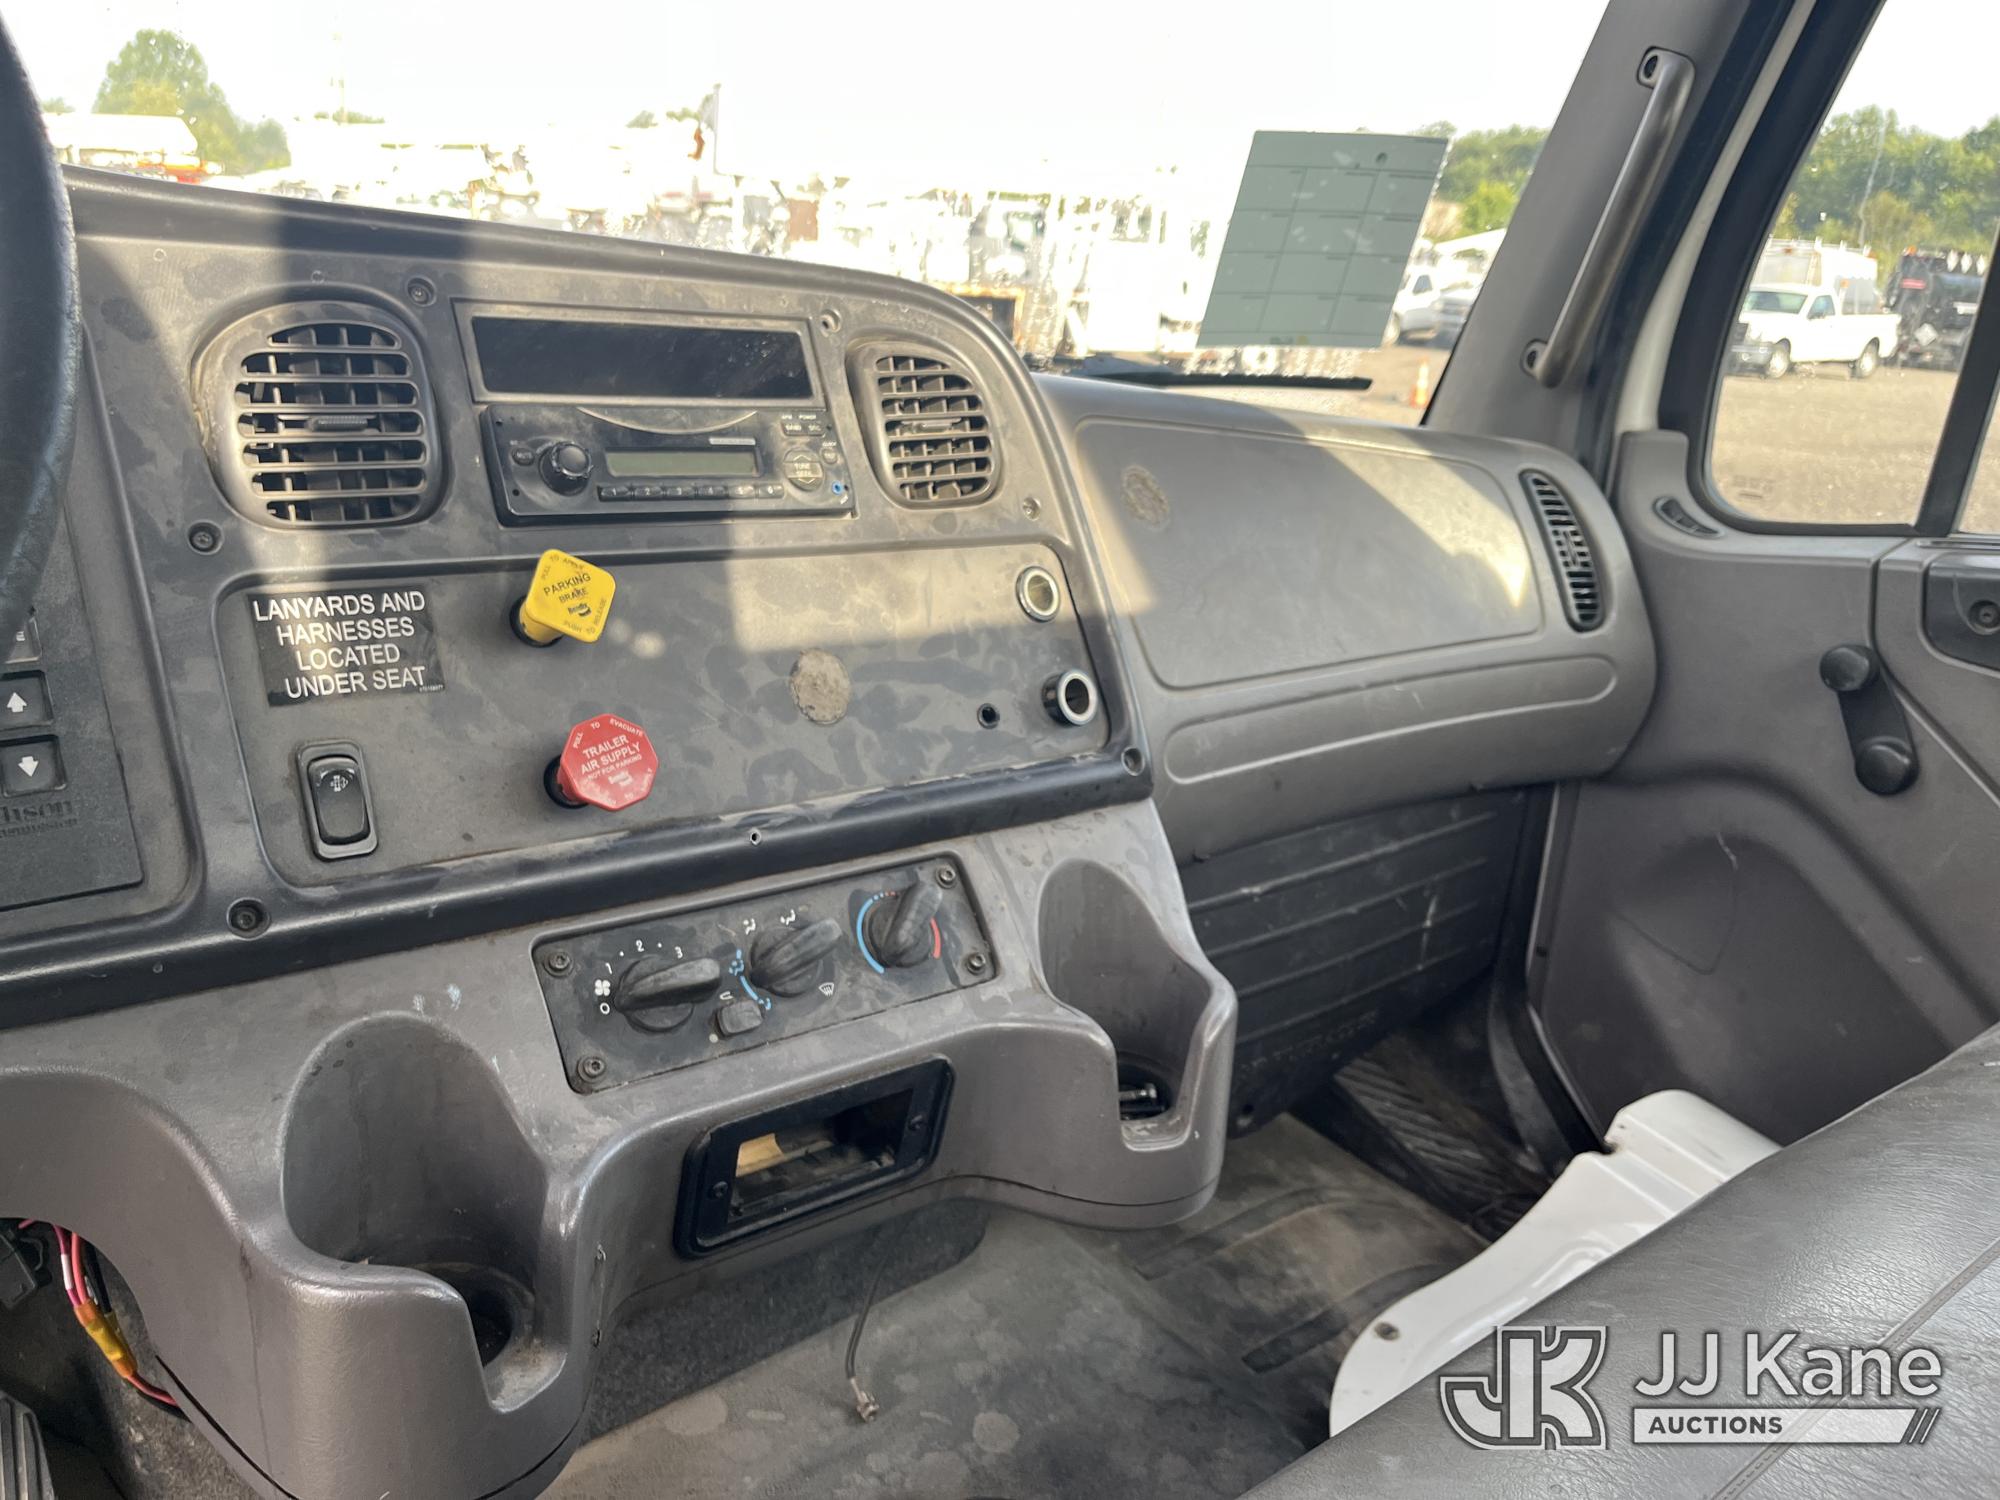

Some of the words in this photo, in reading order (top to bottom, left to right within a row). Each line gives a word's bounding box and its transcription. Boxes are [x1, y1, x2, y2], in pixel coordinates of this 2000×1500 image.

[543, 572, 592, 596] PARKING
[558, 587, 589, 604] BRAKE
[253, 593, 375, 622] LANYARDS
[381, 590, 426, 613] AND
[276, 616, 416, 647] HARNESSES
[296, 643, 401, 671] LOCATED
[284, 672, 368, 699] UNDER
[372, 666, 426, 691] SEAT
[591, 721, 601, 730] TO
[609, 718, 643, 737] EVACUATE
[581, 759, 600, 775] AIR
[600, 742, 641, 766] SUPPLY
[582, 734, 629, 759] TRAILER
[635, 939, 645, 953] 2
[674, 946, 684, 959] 3
[605, 962, 613, 974] 1
